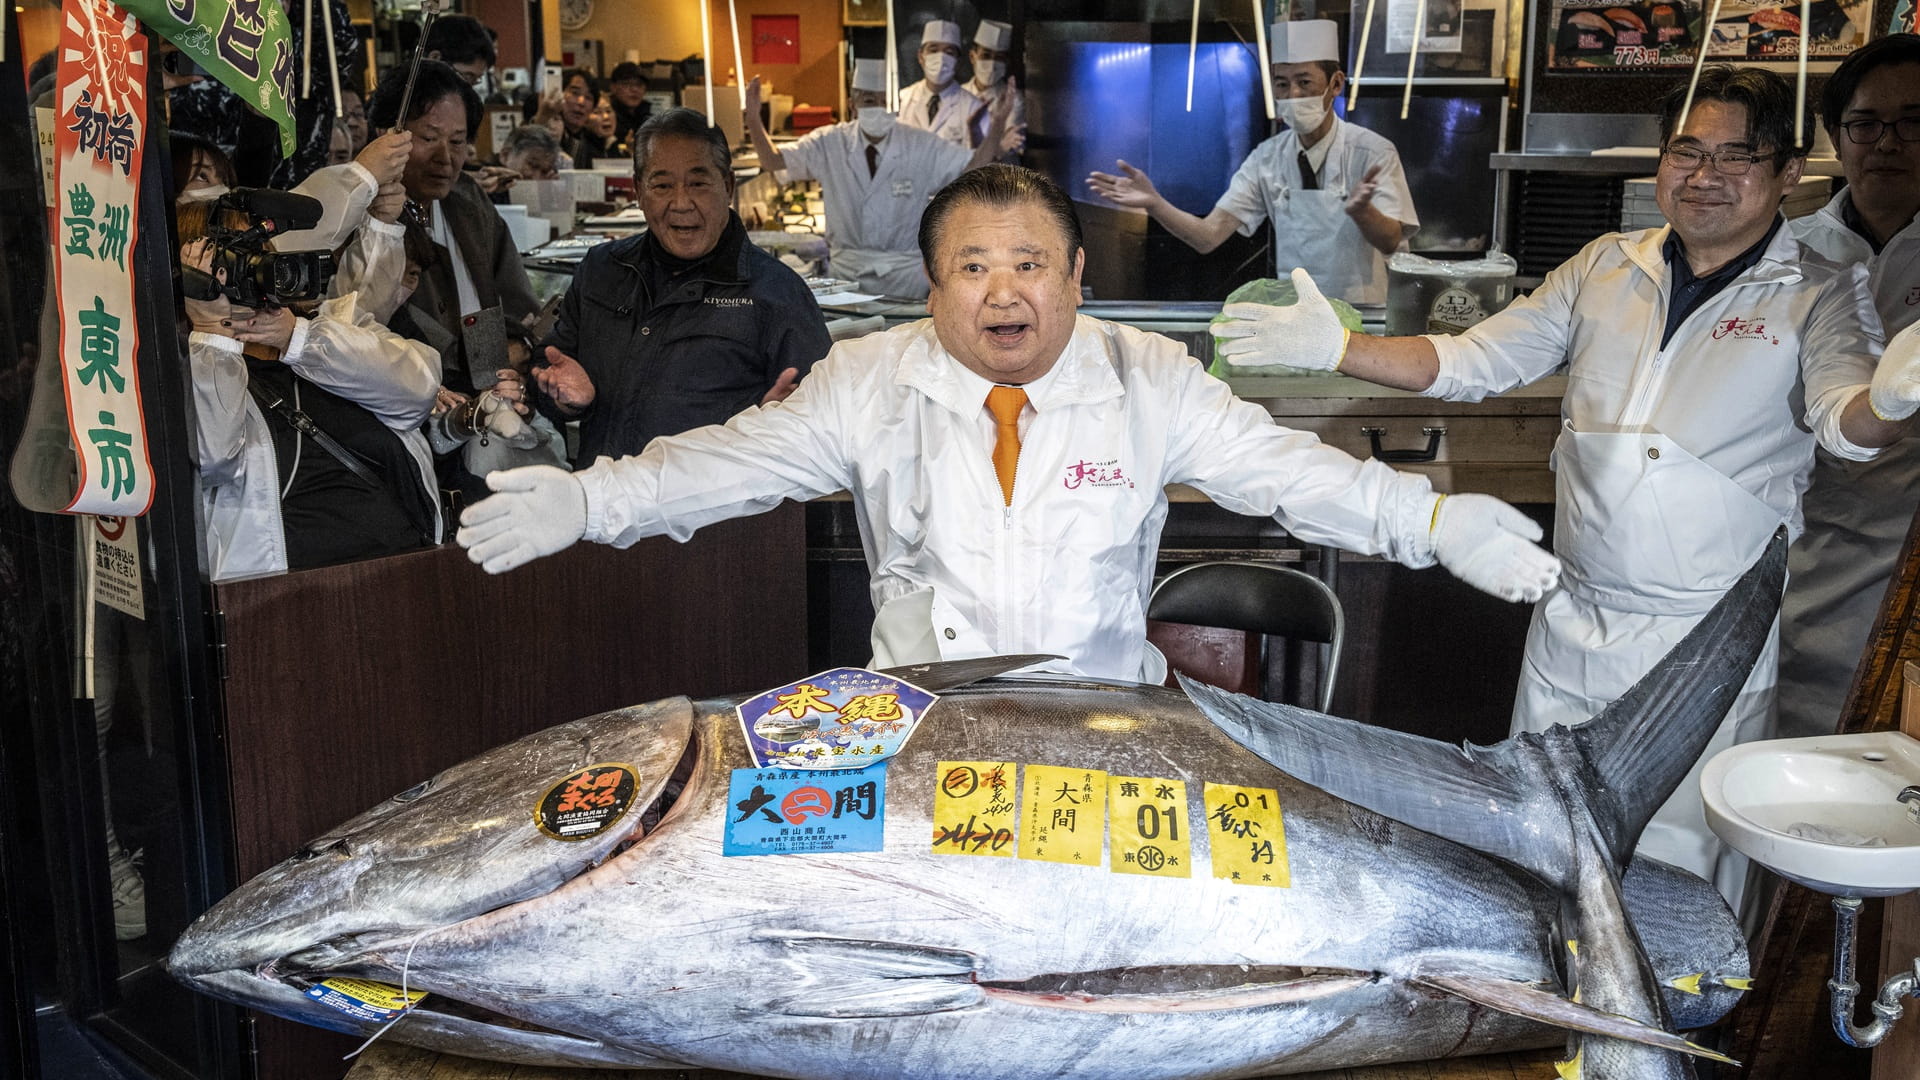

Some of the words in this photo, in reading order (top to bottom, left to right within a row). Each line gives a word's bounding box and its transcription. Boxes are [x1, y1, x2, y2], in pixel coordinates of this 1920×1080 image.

[1614, 46, 1660, 65] 773円
[68, 90, 136, 177] 初荷
[63, 182, 129, 273] 豊洲
[703, 297, 754, 305] KIYOMURA
[1434, 304, 1476, 315] クッキング
[1446, 295, 1467, 305] エコ
[76, 295, 136, 501] 東市
[769, 684, 904, 725] 本縄
[564, 769, 623, 793] 大間
[755, 771, 801, 781] 青森県産
[1082, 773, 1093, 803] 青森県
[1119, 782, 1175, 800] 東水
[557, 787, 616, 812] まぐろ
[733, 785, 785, 824] 大
[832, 781, 877, 820] 間
[1051, 781, 1081, 833] 大間
[1234, 792, 1269, 810] 01
[780, 826, 826, 835] 西山商店
[1137, 804, 1178, 841] 01
[1038, 826, 1049, 844] 延縄
[1124, 852, 1135, 863] 東
[1167, 855, 1178, 866] 水
